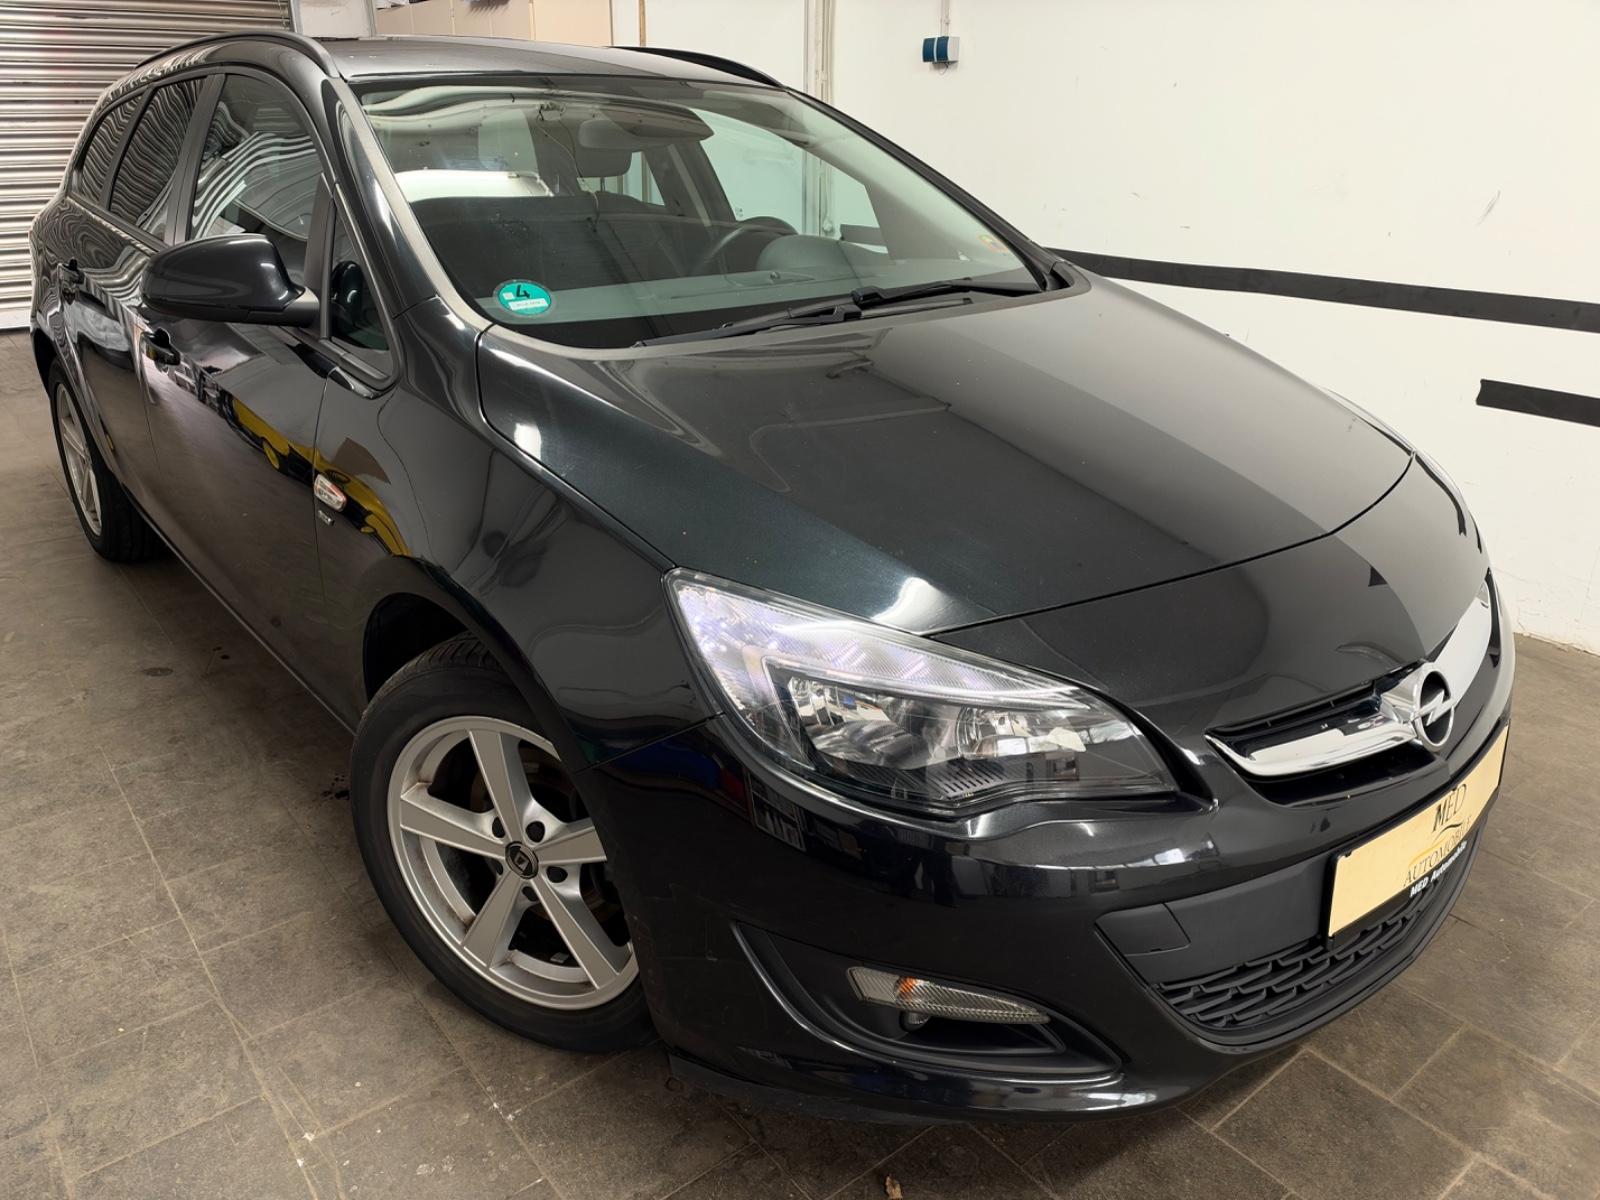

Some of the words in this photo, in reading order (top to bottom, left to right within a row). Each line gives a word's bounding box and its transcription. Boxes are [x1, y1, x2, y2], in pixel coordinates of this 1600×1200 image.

[516, 284, 530, 298] 4
[1432, 783, 1467, 832] MED
[1410, 876, 1430, 898] MED
